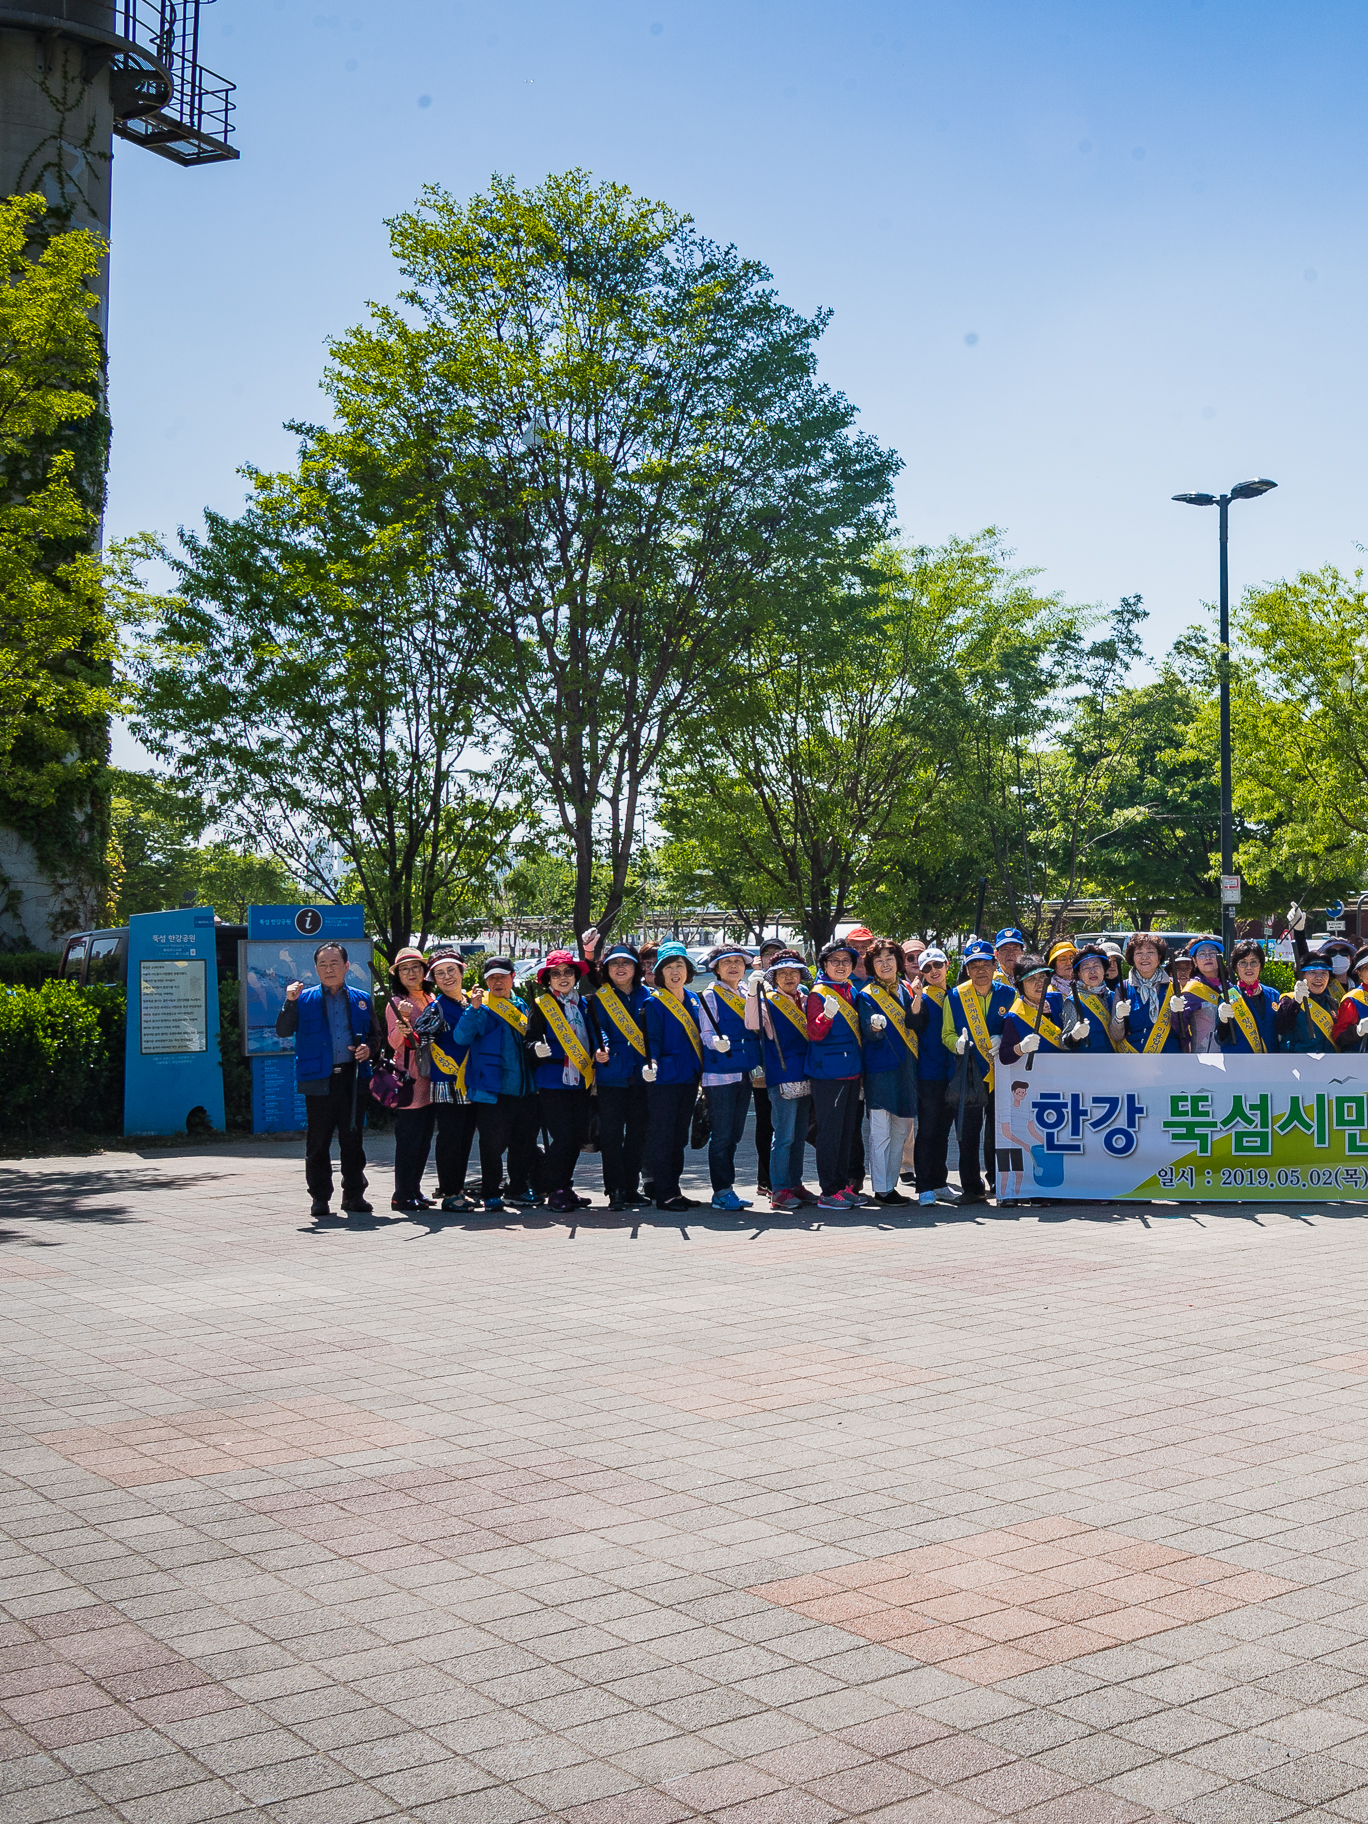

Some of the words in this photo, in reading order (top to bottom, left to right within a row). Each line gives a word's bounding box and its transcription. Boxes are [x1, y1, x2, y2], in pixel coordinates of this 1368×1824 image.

[152, 935, 166, 943] 뚝섬
[168, 935, 196, 943] 한강공원
[545, 1005, 574, 1045] 바르게살기운동
[607, 1000, 636, 1037] 바르게살기운동
[964, 996, 986, 1036] 바르게살기운동
[1031, 1091, 1147, 1157] 한강
[1157, 1166, 1195, 1190] 일시
